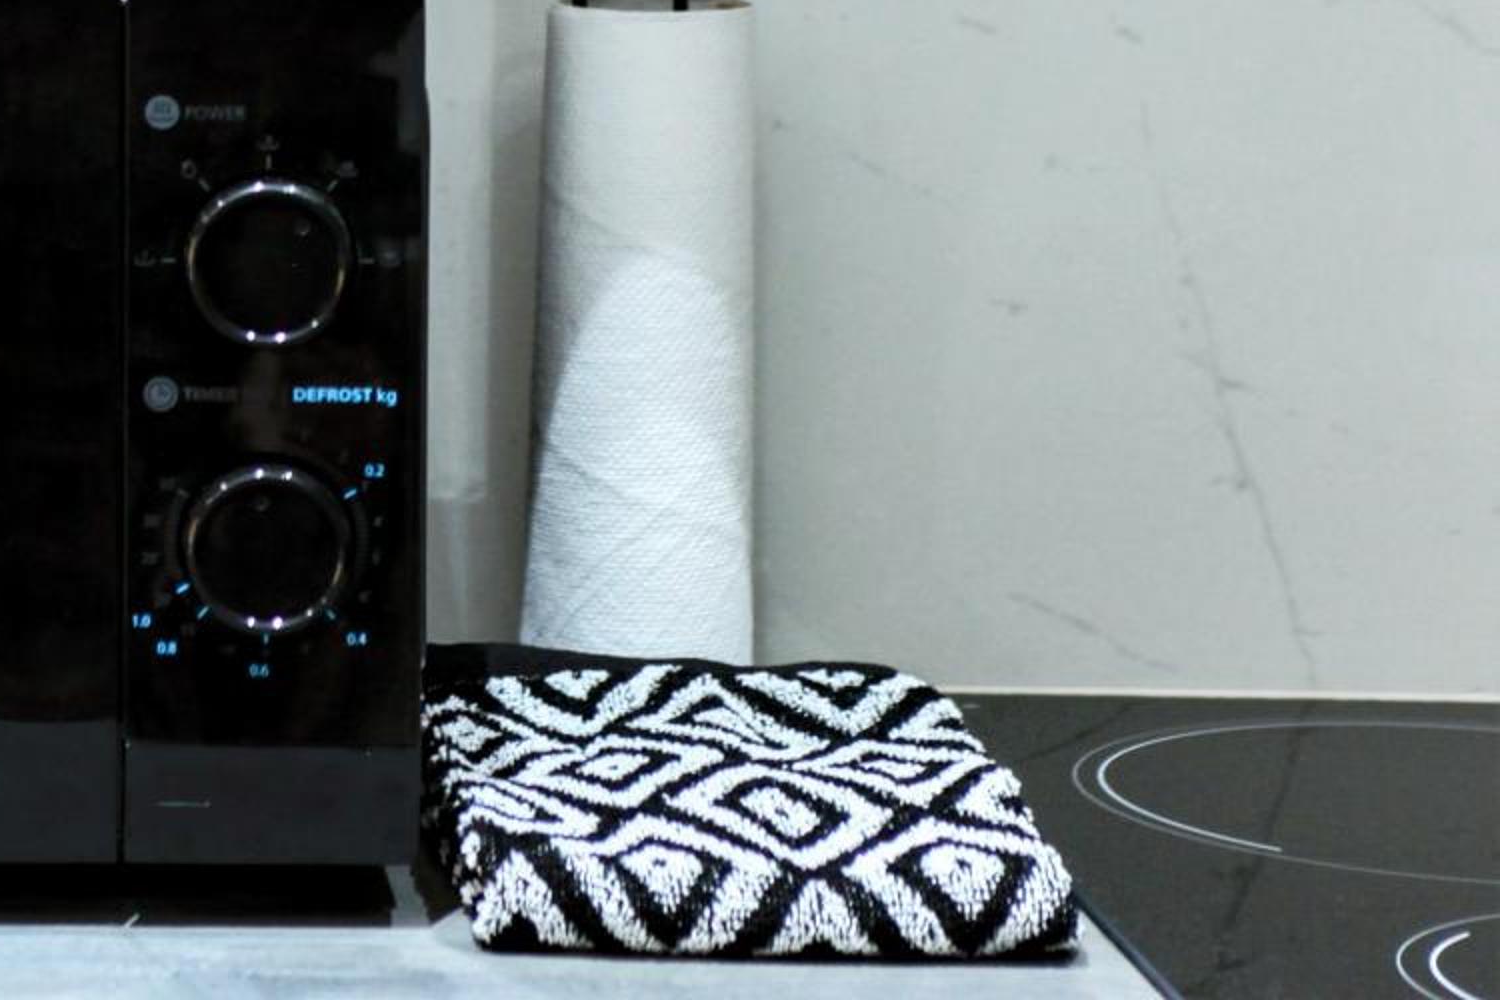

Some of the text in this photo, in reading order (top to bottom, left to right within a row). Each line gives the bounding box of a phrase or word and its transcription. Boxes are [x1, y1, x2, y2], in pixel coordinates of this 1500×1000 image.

[184, 105, 247, 121] POWER
[292, 386, 399, 408] DEFROST kg
[363, 463, 386, 478] 0.2
[346, 631, 368, 646] 0.4
[248, 663, 270, 679] 0.6
